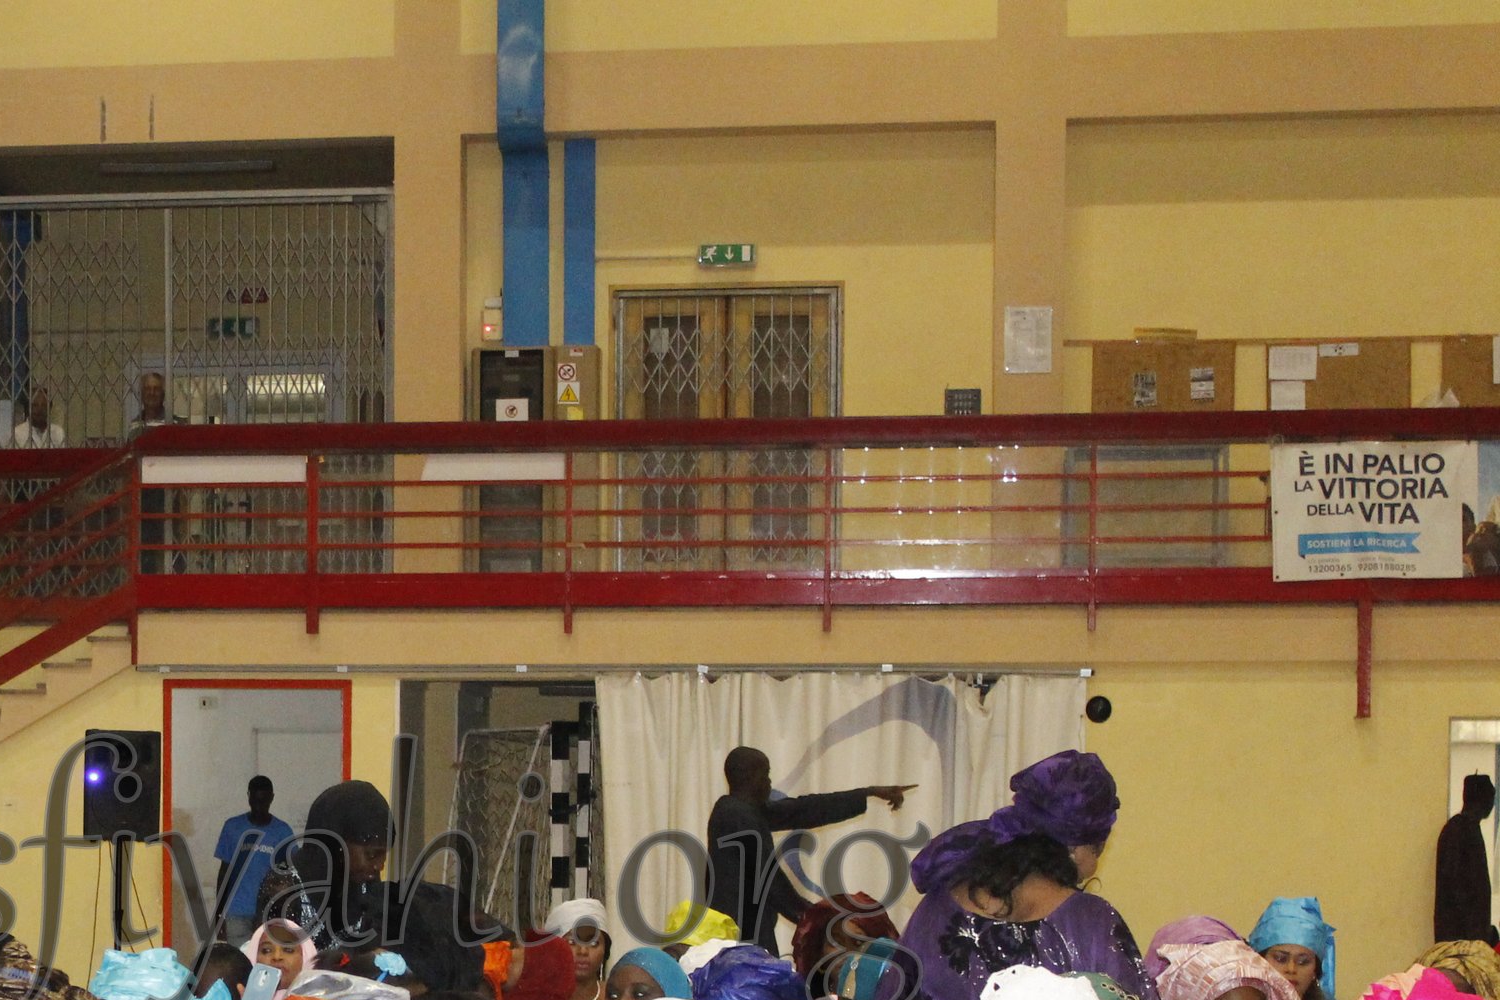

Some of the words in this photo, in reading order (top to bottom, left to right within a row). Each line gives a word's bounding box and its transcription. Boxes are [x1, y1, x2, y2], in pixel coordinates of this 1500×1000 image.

[1299, 451, 1315, 476] È
[1325, 453, 1353, 475] IN
[1363, 453, 1445, 475] PALIO
[1294, 480, 1313, 492] LA
[1318, 477, 1449, 500] VITTORIA
[1307, 503, 1354, 517] DELLA
[1358, 501, 1420, 524] VITA
[1307, 540, 1350, 549] SOSTIENI
[1353, 538, 1365, 547] LA
[1367, 537, 1407, 548] RICERCA
